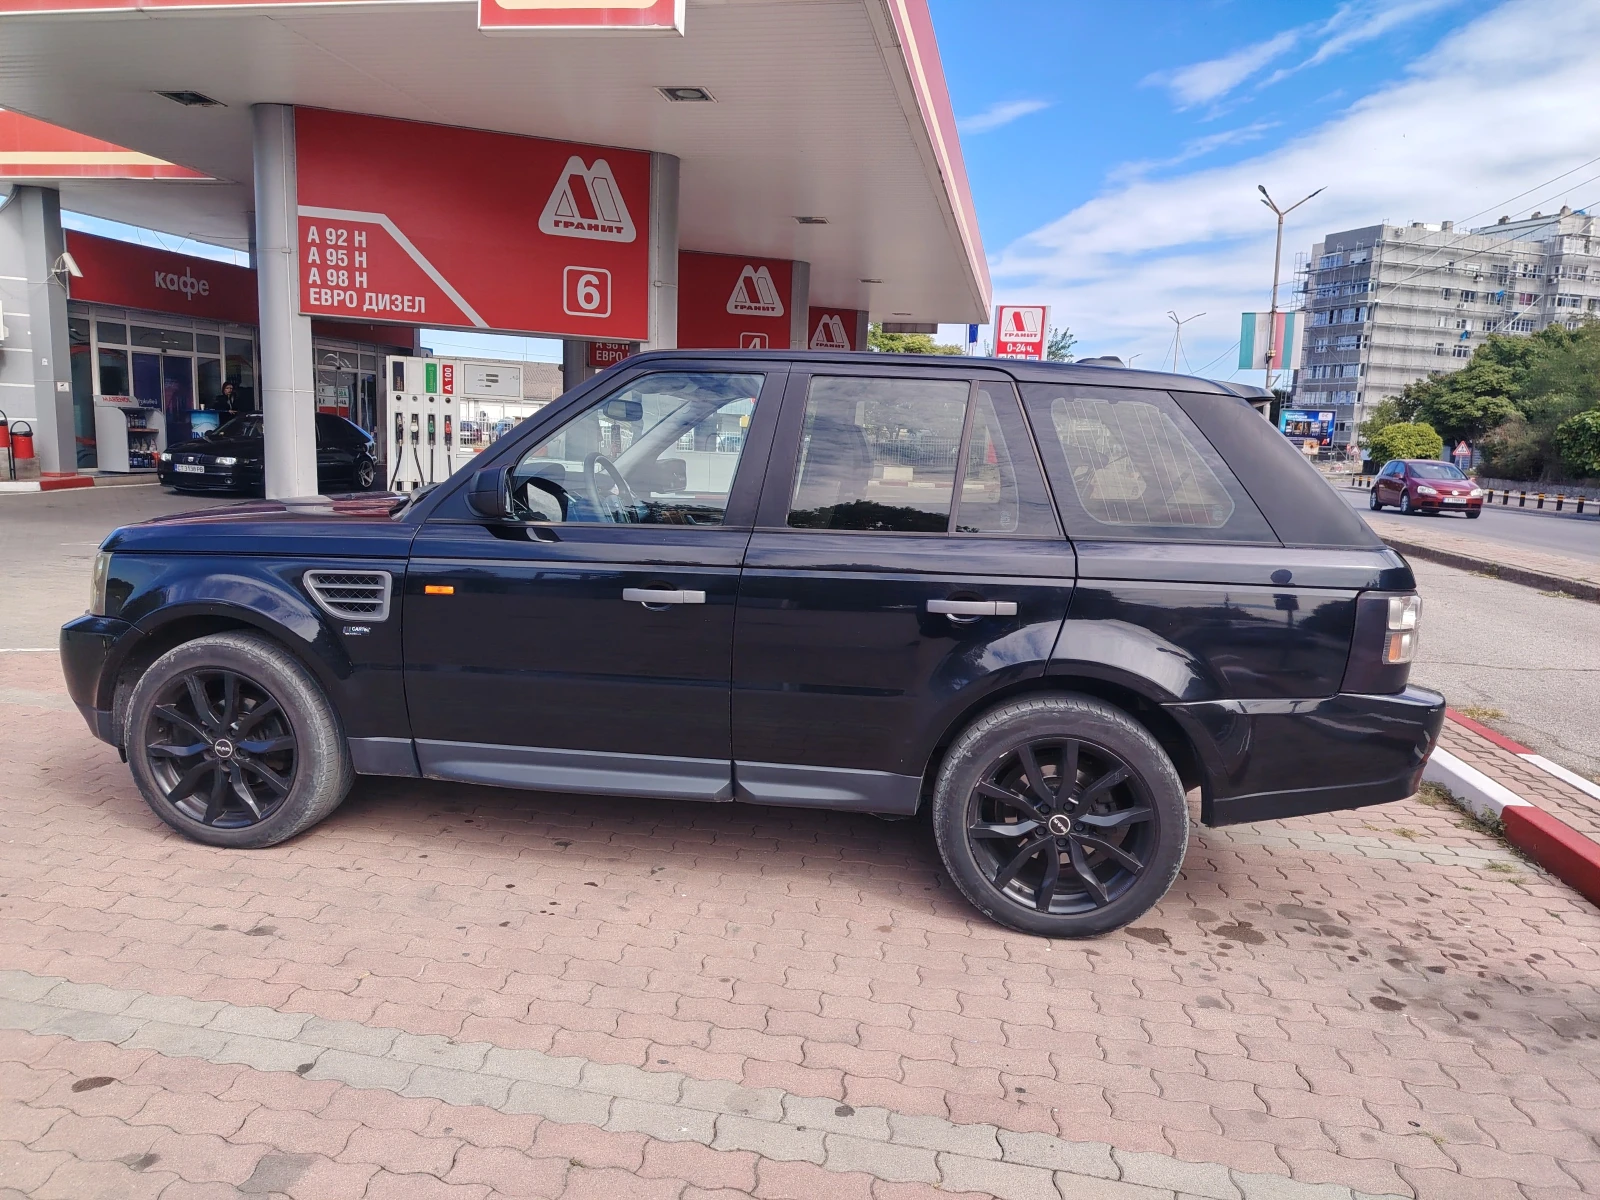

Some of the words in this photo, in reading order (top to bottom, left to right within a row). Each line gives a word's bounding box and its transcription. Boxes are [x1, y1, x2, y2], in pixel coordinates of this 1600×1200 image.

[307, 225, 320, 244] А
[325, 227, 348, 247] 92
[354, 230, 367, 248] Н
[554, 219, 624, 234] ГРАНИТ
[307, 246, 321, 264] А
[326, 248, 348, 267] 95
[354, 250, 367, 268] Н
[154, 266, 210, 301] кафе
[308, 267, 321, 285] А
[326, 269, 349, 287] 98
[355, 271, 367, 289] Н
[309, 287, 358, 308] ЕВРО
[363, 292, 426, 313] ДИЗЕЛ
[577, 273, 600, 310] 6
[734, 304, 776, 312] ГРАНИТ
[596, 350, 623, 362] ЕВРО
[1007, 343, 1025, 352] 0-24
[444, 367, 452, 381] 100
